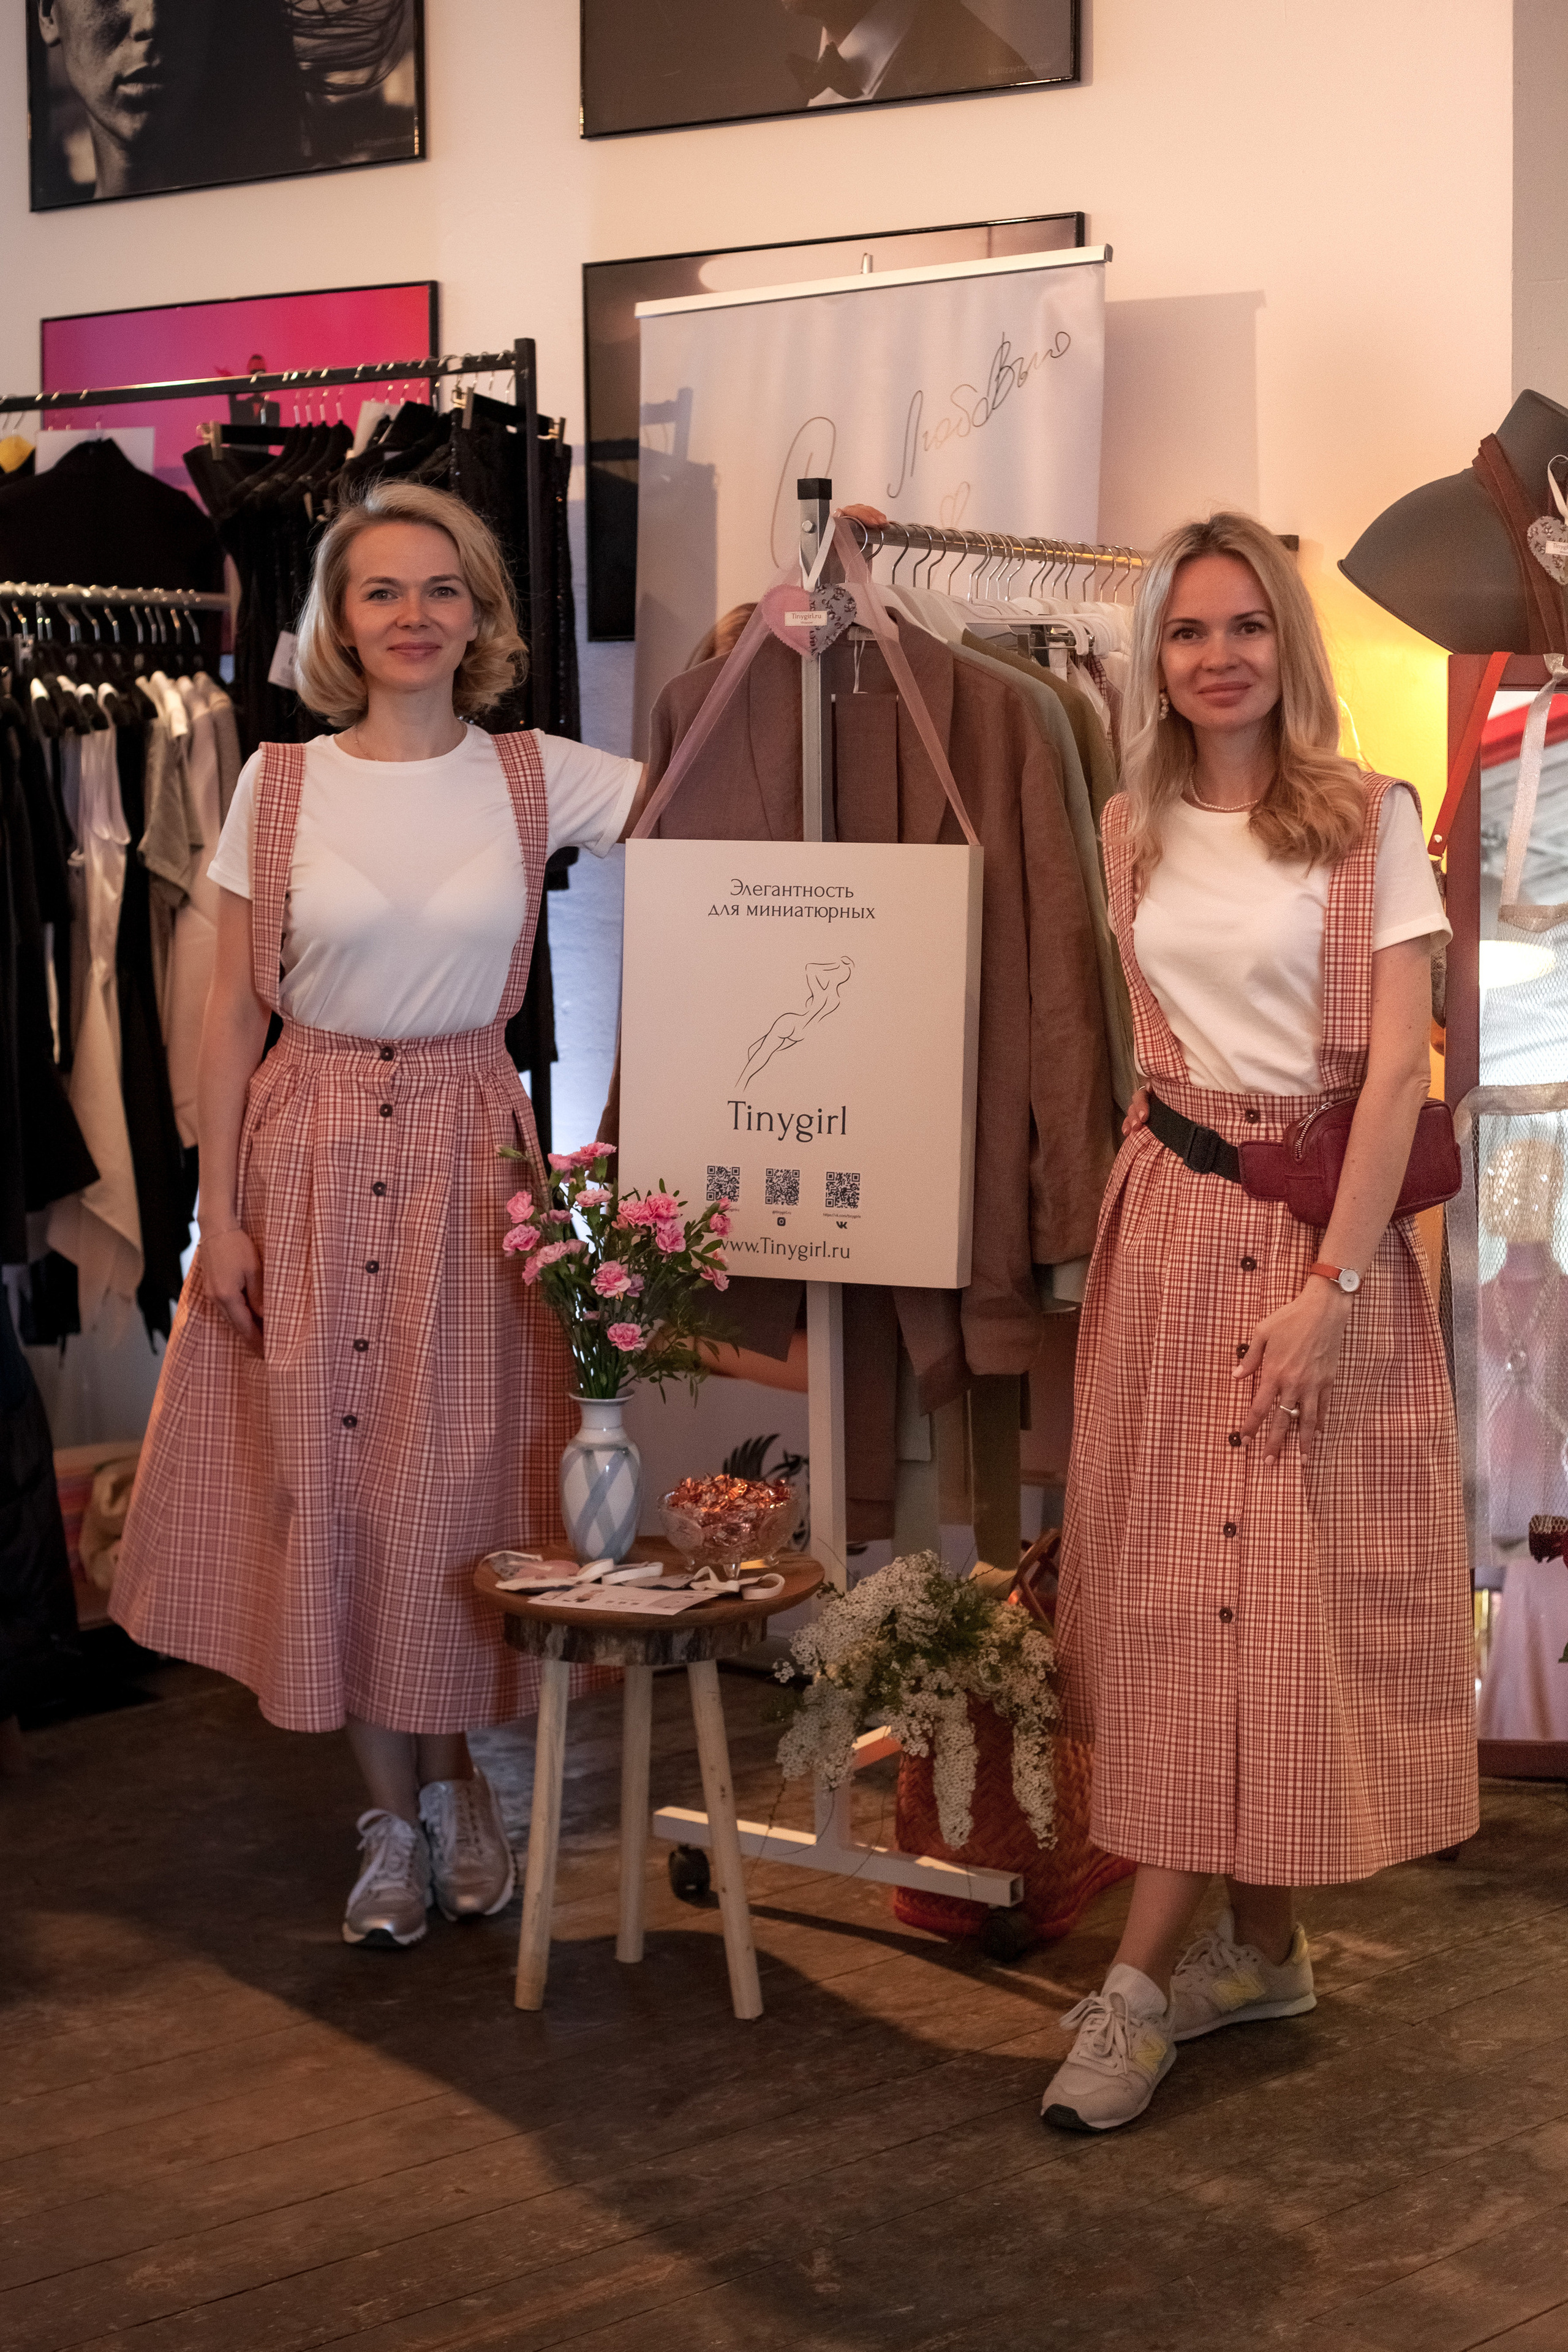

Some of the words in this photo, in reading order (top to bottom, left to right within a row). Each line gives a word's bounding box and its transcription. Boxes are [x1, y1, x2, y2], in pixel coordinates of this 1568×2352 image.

[730, 878, 854, 898] Элегантность
[708, 904, 739, 916] для
[747, 905, 876, 923] миниатюрных
[727, 1100, 846, 1143] Tinygirl
